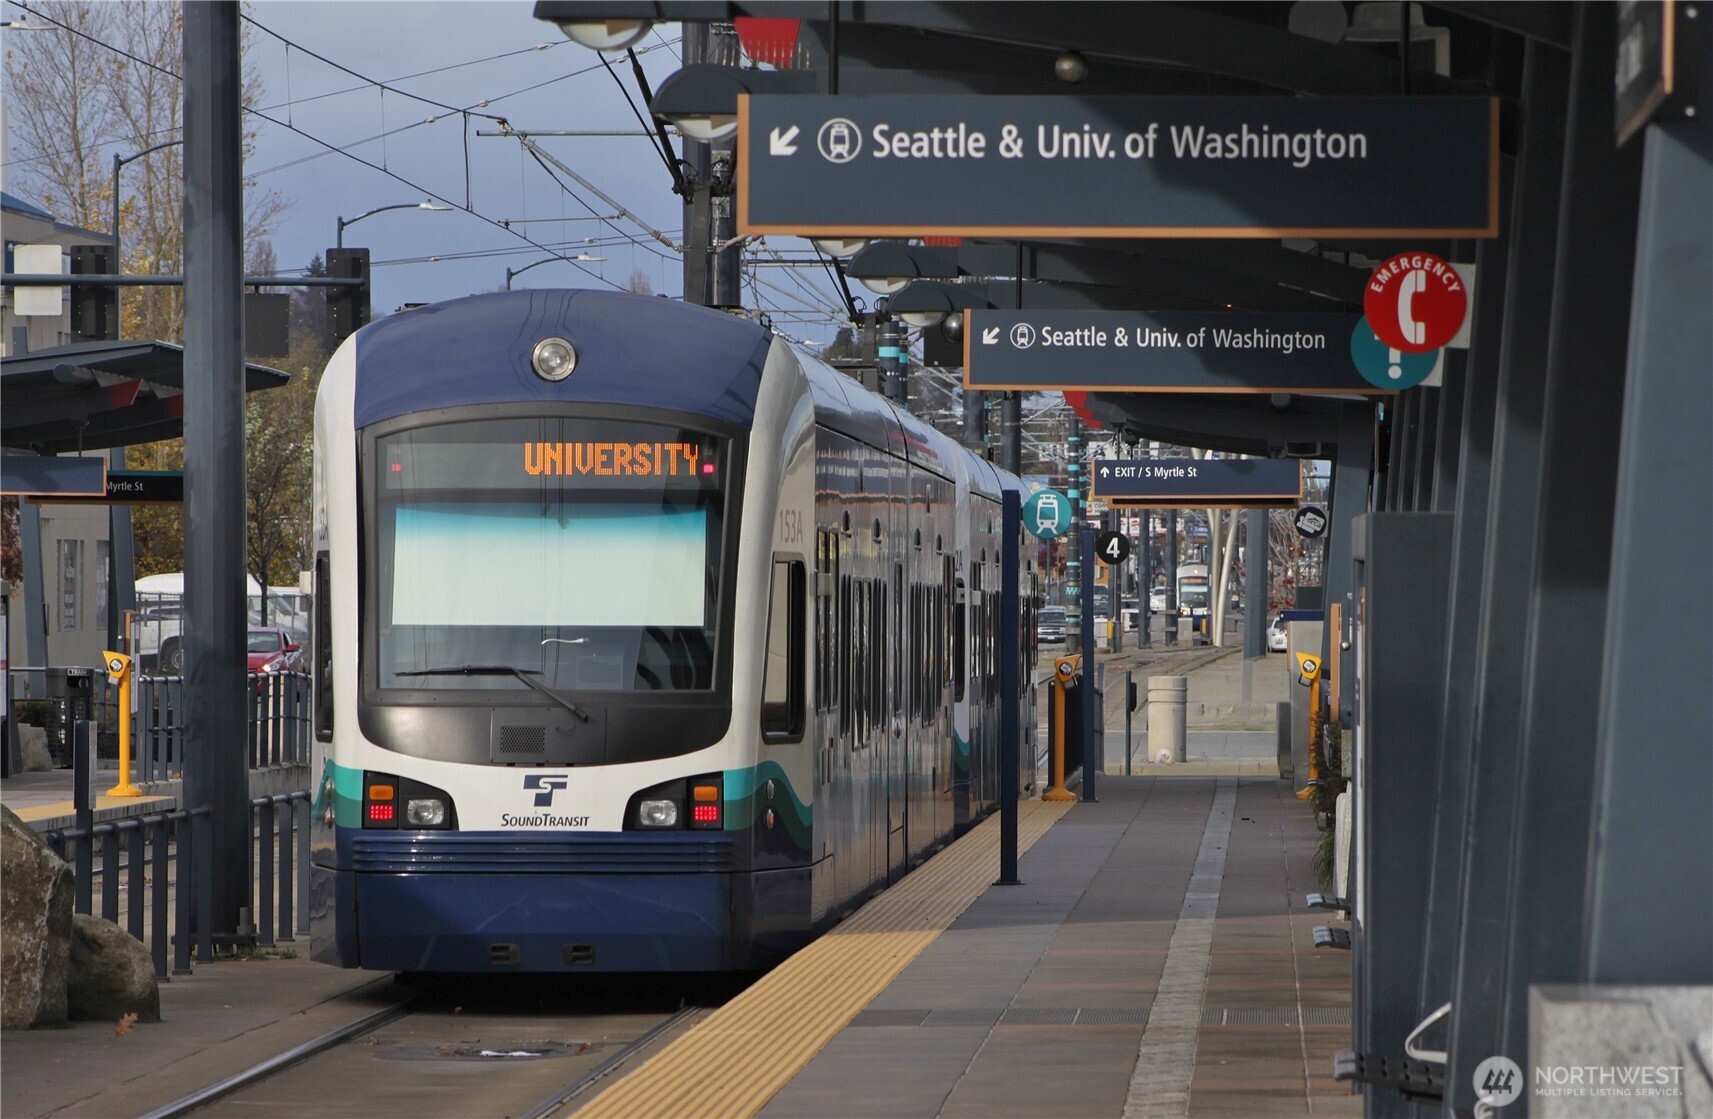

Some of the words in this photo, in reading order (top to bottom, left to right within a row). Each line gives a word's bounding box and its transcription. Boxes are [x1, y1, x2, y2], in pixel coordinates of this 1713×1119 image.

[873, 122, 986, 158] Seattle
[999, 124, 1024, 158] &
[1038, 124, 1116, 158] Univ.
[1124, 123, 1159, 159] of
[1170, 123, 1368, 168] Washington
[1370, 256, 1460, 293] EMERGENCY
[1041, 326, 1107, 347] Seattle
[1114, 327, 1129, 347] &
[1136, 328, 1181, 347] Univ.
[1186, 327, 1206, 348] of
[1212, 328, 1326, 354] Washington
[524, 442, 698, 476] UNIVERSITY
[1114, 466, 1136, 478] EXIT
[1137, 466, 1143, 479] /
[1145, 466, 1151, 478] S
[1154, 466, 1185, 480] Myrtle
[1187, 466, 1197, 478] St
[134, 481, 144, 491] St
[779, 509, 804, 544] 153A
[1106, 537, 1120, 559] 4
